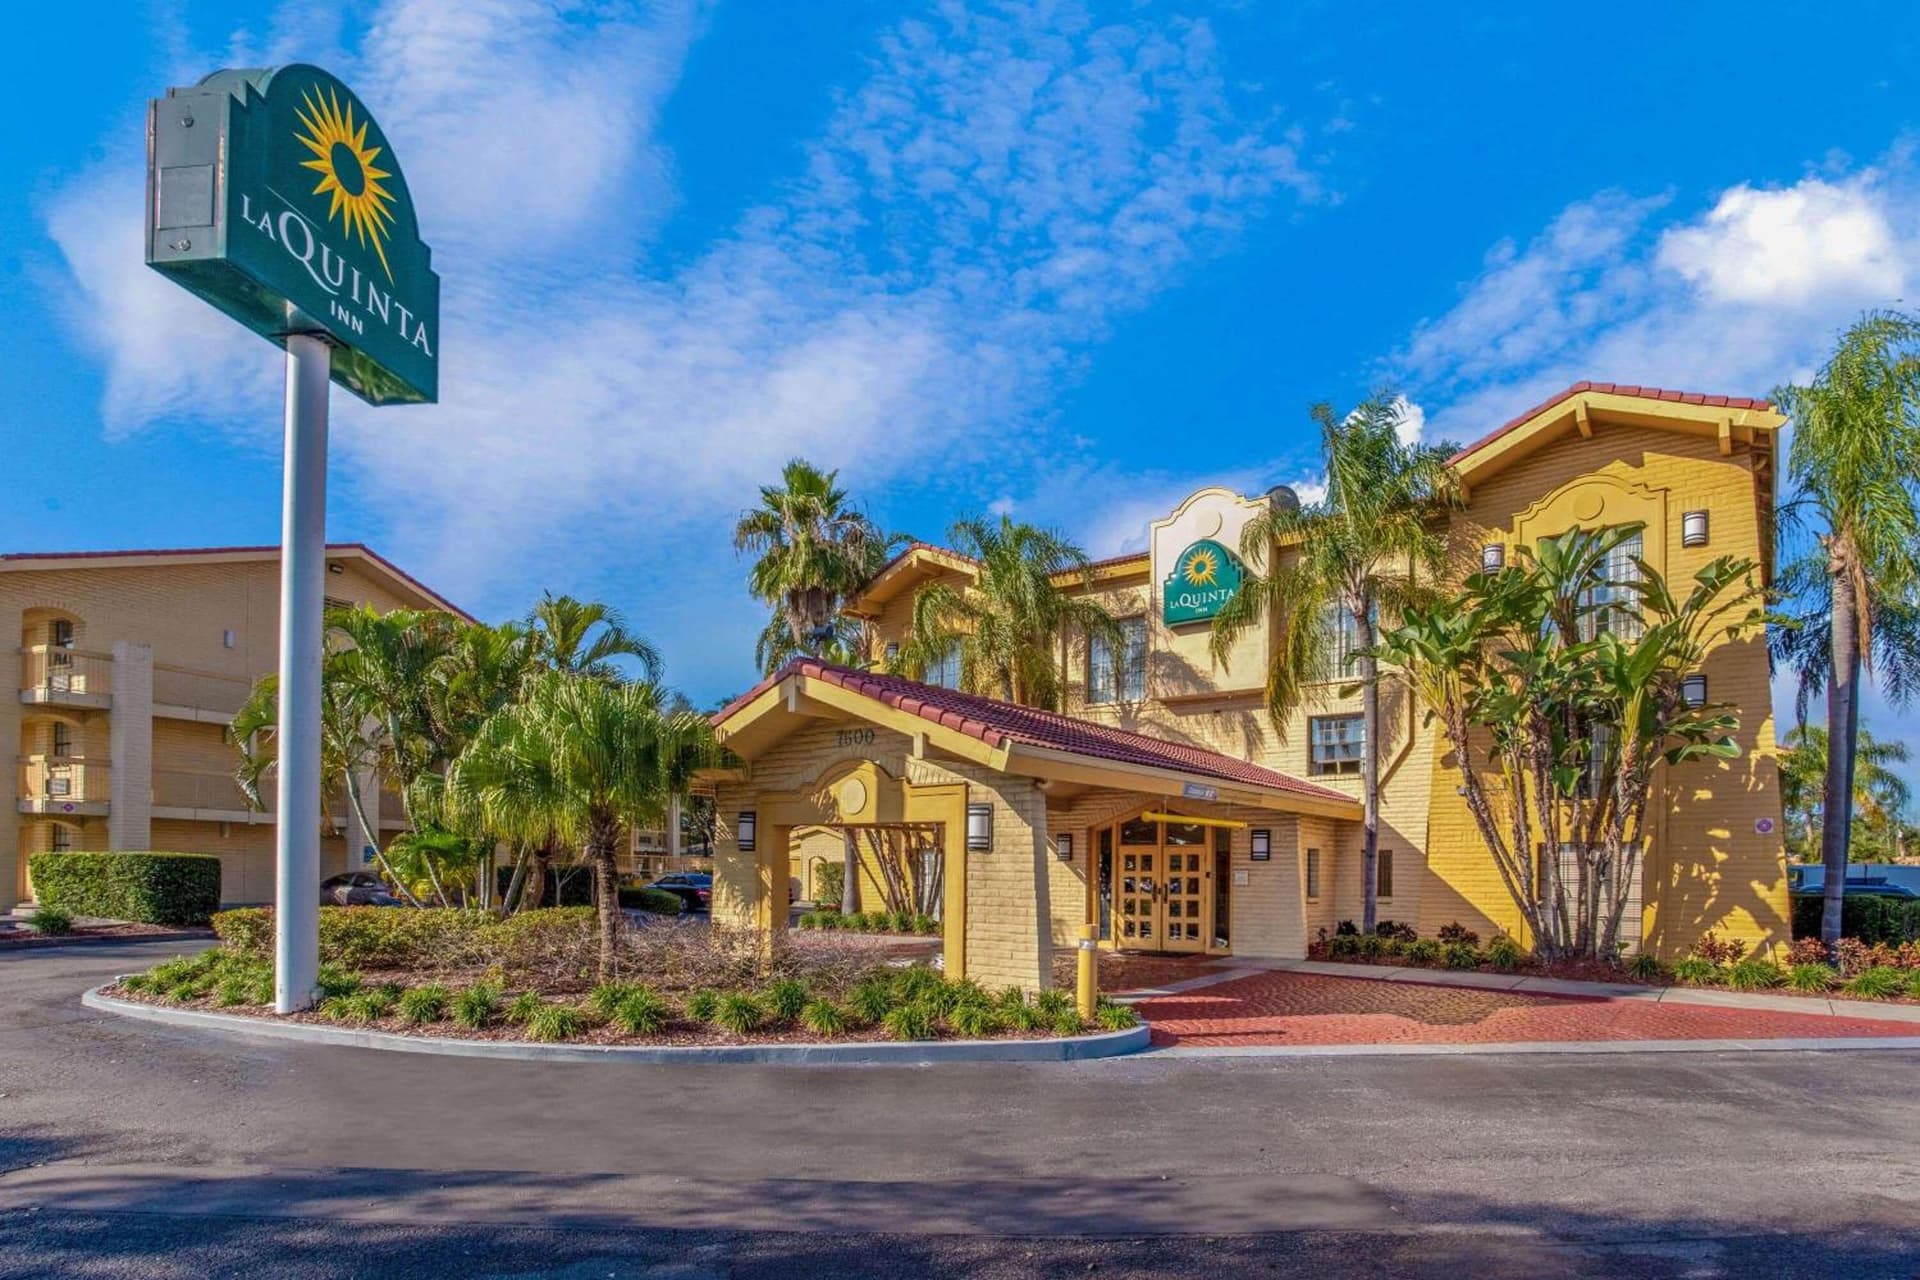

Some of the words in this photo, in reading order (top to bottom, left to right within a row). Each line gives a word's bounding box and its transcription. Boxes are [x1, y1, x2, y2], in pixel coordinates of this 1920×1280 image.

[241, 193, 278, 242] LA
[278, 210, 433, 358] QUINTA
[330, 300, 363, 335] INN
[1170, 601, 1180, 609] LA
[1179, 588, 1235, 608] QUINTA
